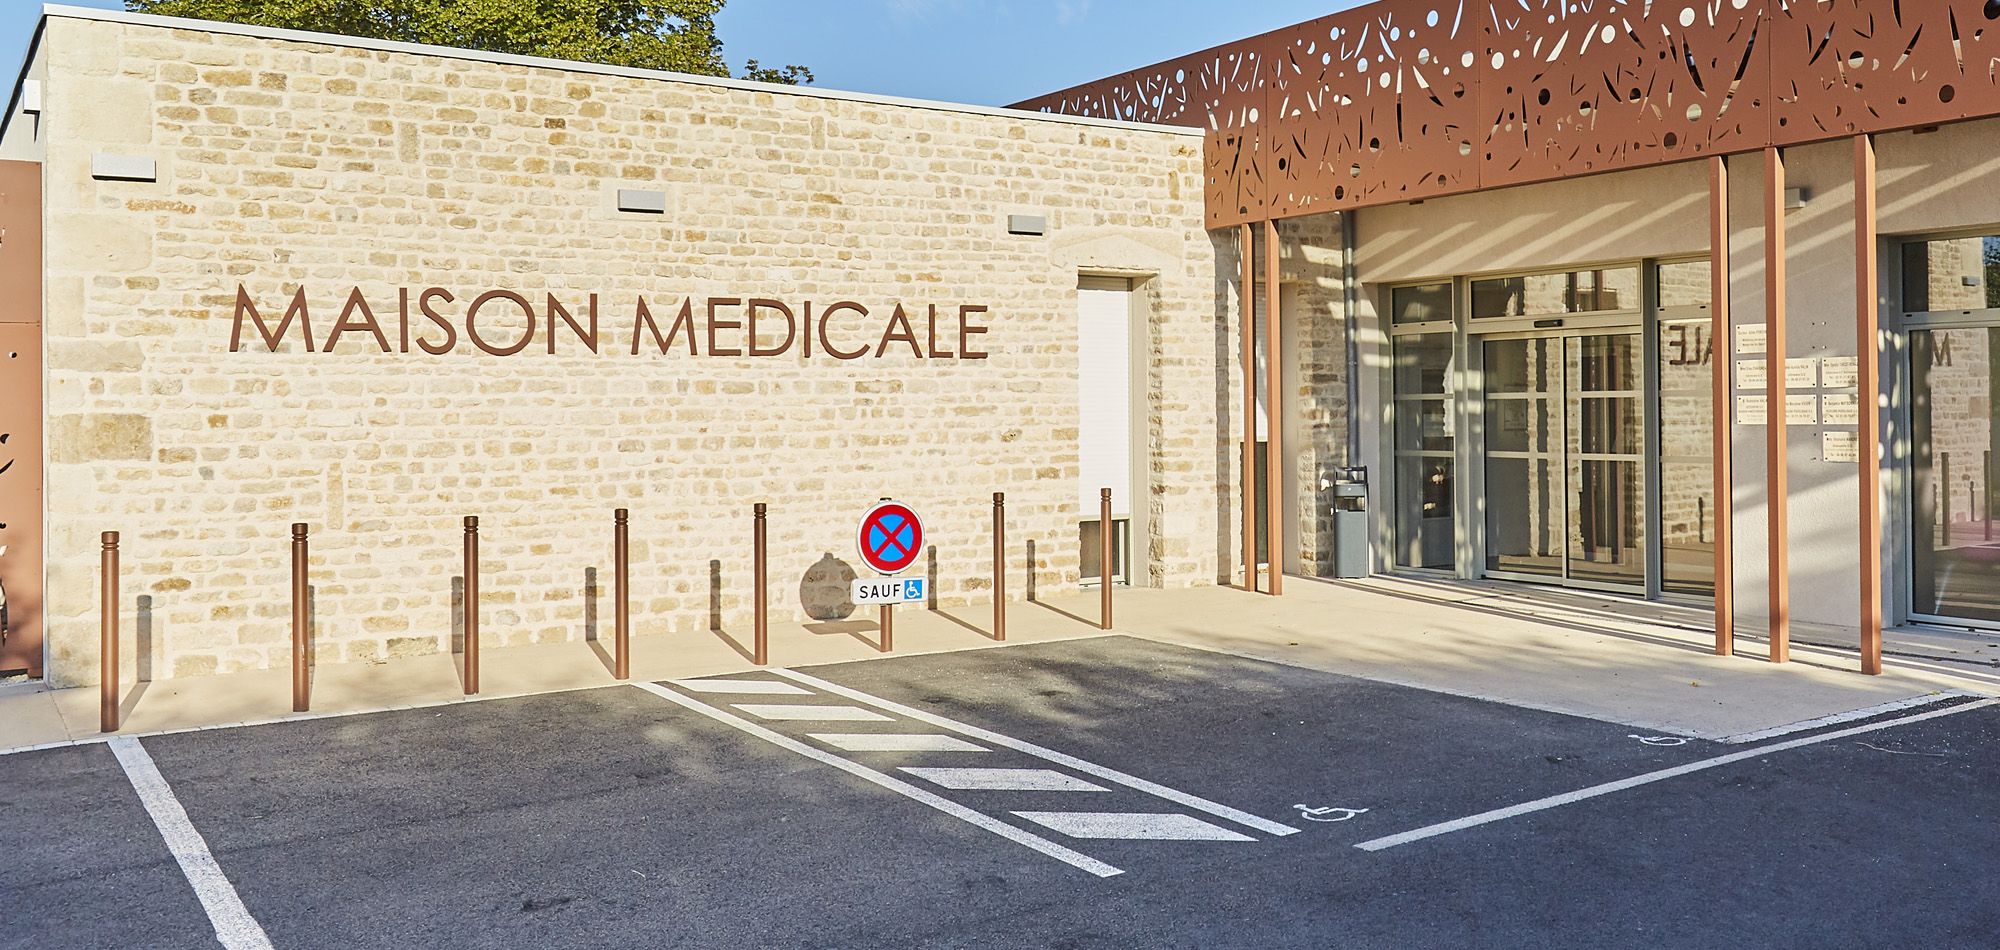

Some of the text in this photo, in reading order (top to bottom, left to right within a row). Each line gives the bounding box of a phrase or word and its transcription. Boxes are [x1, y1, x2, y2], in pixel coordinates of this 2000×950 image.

[229, 283, 989, 360] MAISON MEDICALE
[859, 583, 901, 599] SAUF
